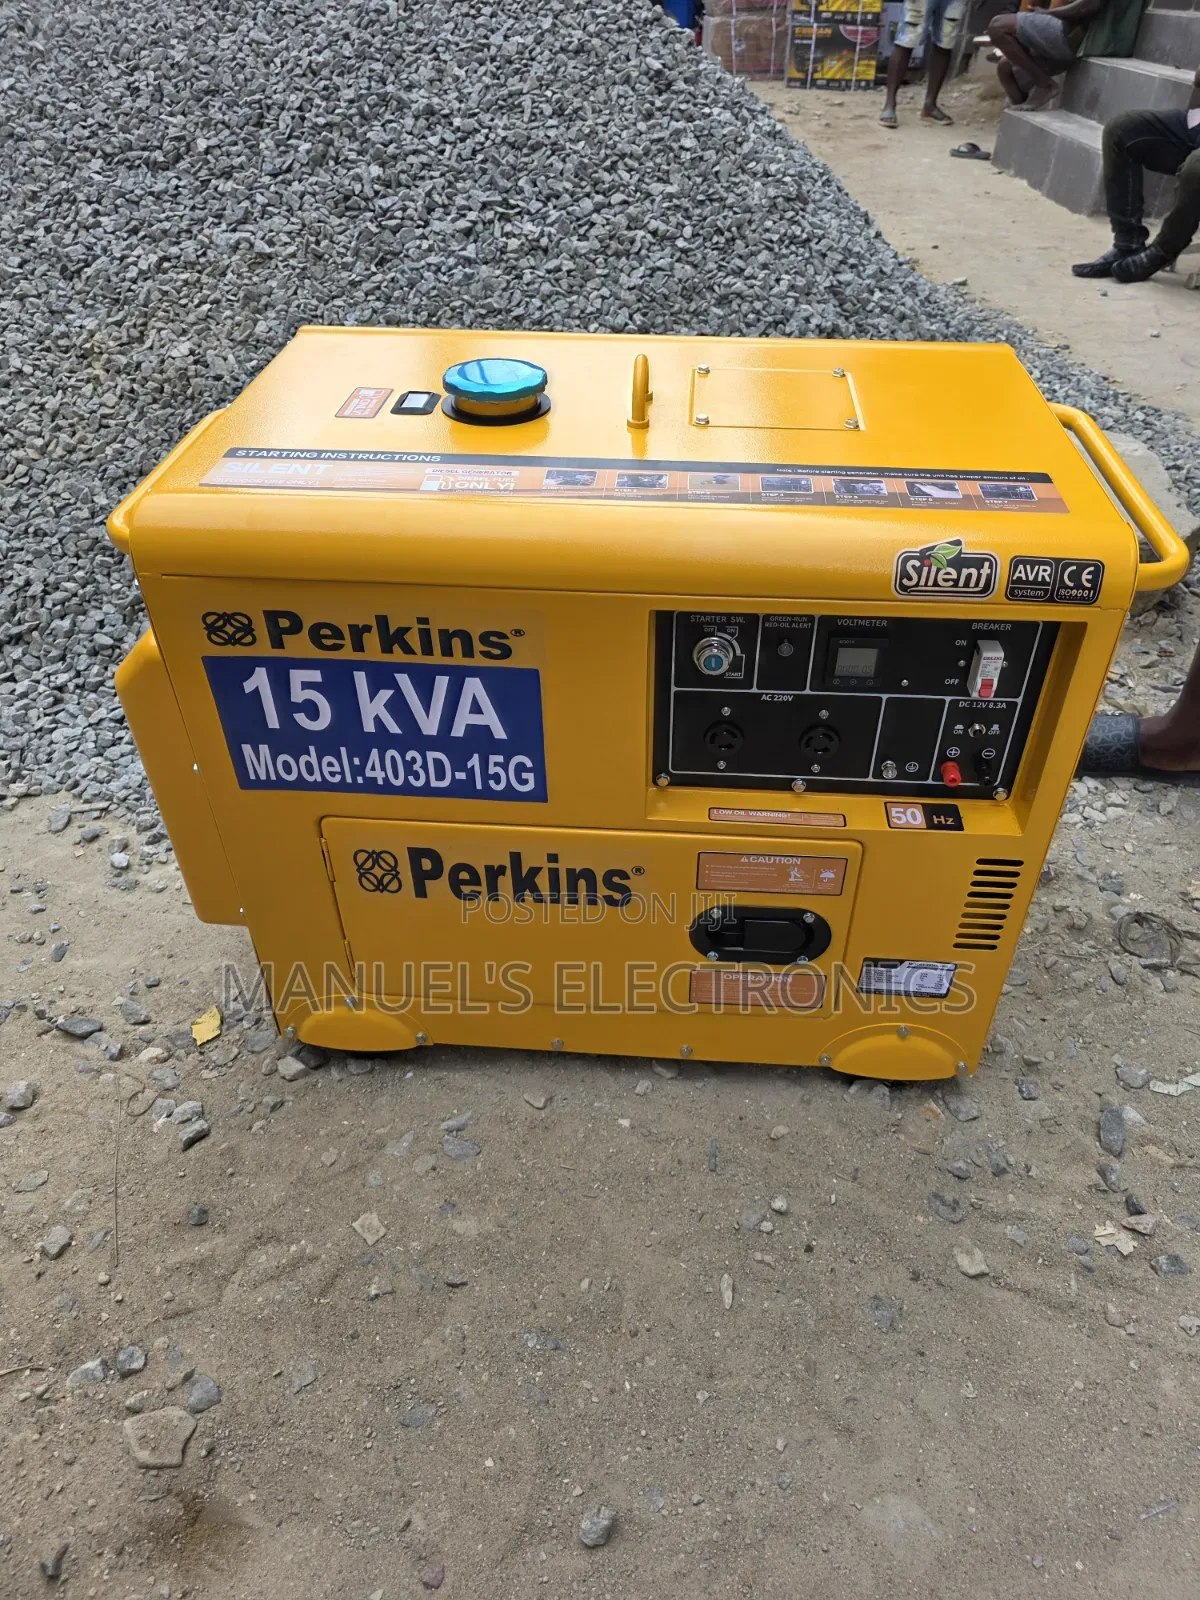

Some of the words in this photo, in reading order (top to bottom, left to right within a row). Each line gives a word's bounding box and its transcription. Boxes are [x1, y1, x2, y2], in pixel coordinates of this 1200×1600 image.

[235, 450, 318, 459] STARTING
[320, 451, 441, 462] INSTRUCTIONS
[222, 462, 334, 475] SILENT
[454, 481, 515, 491] ONLY!
[902, 558, 991, 589] Silent
[1012, 564, 1051, 583] AVR
[1063, 565, 1095, 588] CE
[1014, 588, 1044, 598] system
[1058, 588, 1094, 598] ISO9001
[690, 615, 727, 624] STARTER
[730, 616, 746, 624] SW.
[837, 618, 888, 627] VOLTMETER
[971, 622, 1012, 631] BREAKER
[242, 666, 332, 731] 15
[352, 671, 508, 740] kVA
[773, 694, 794, 702] 220V
[240, 743, 536, 793] Model:403D-15G
[890, 807, 922, 825] 50
[932, 815, 955, 825] Hz
[750, 855, 801, 865] CAUTION
[723, 974, 793, 983] OPERATION
